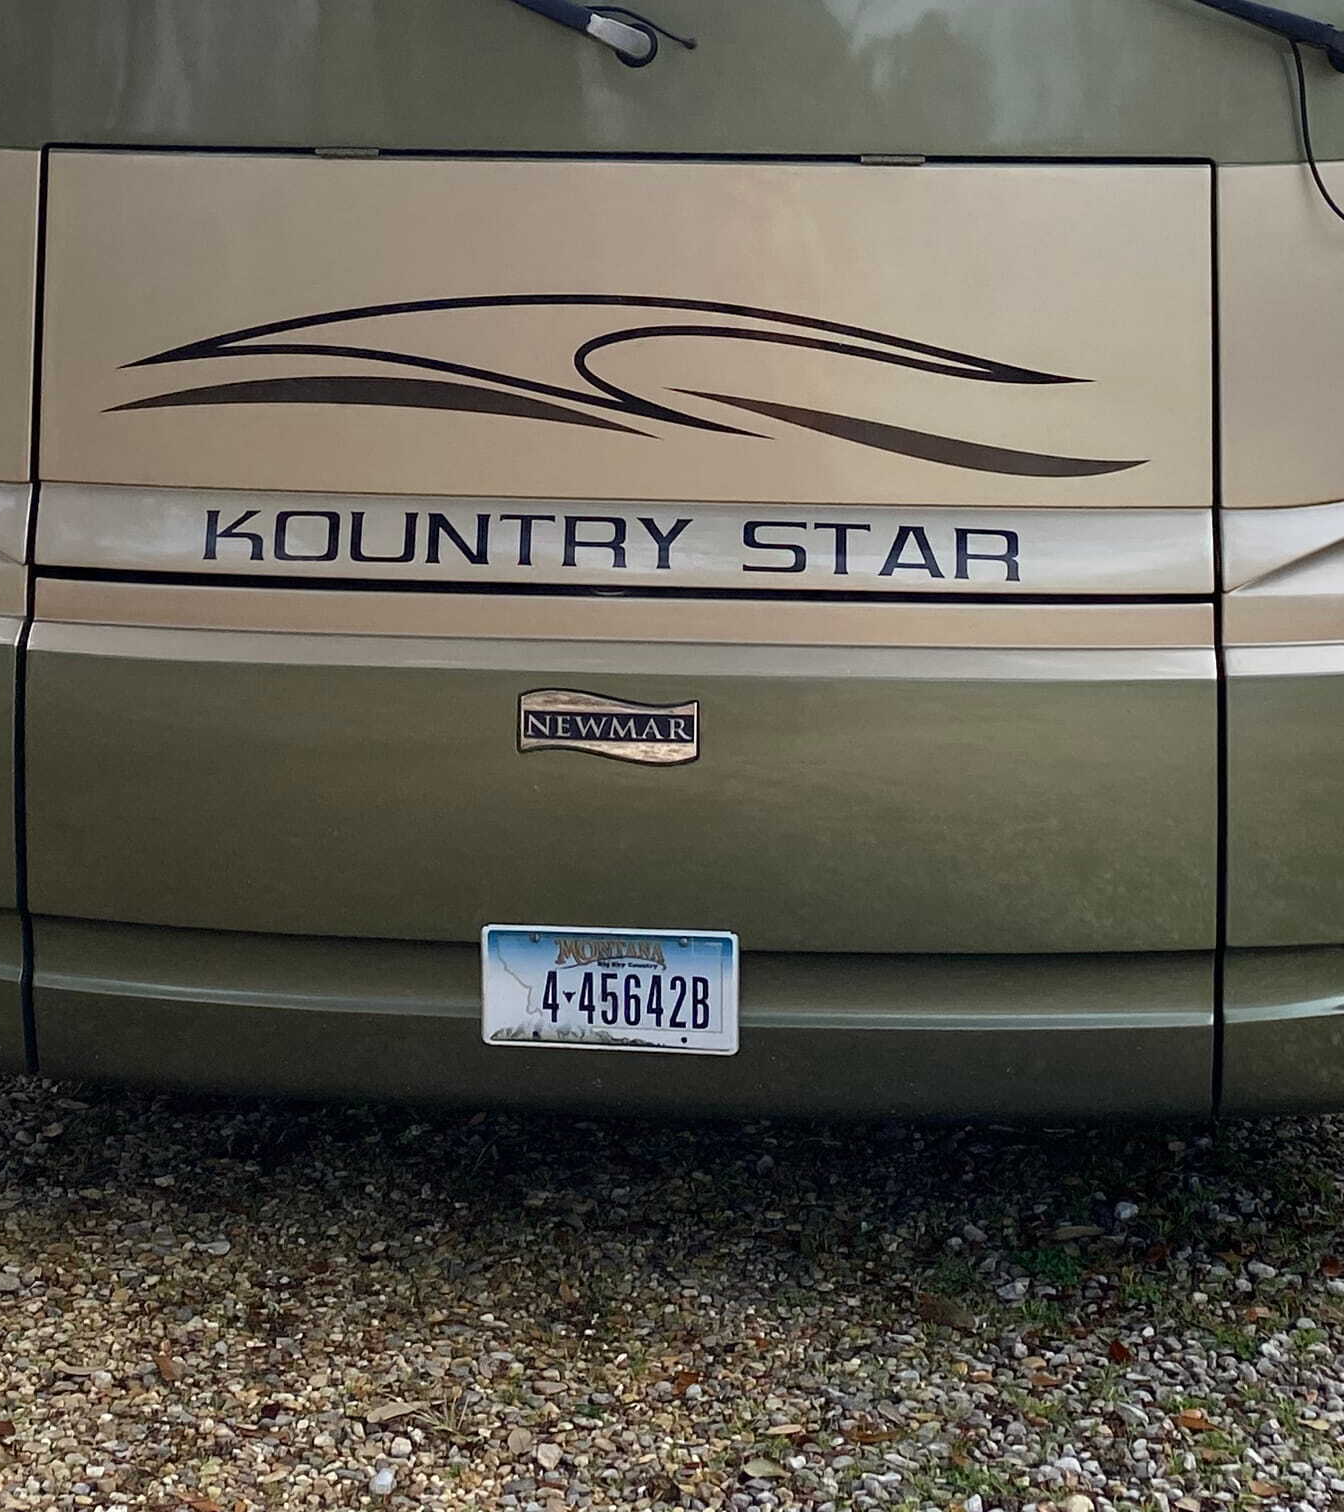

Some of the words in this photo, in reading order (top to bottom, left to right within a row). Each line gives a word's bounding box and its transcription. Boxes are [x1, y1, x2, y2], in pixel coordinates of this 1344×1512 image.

[203, 509, 693, 570] KOUNTRY
[741, 521, 1020, 581] STAR
[525, 713, 691, 742] NEWMAR
